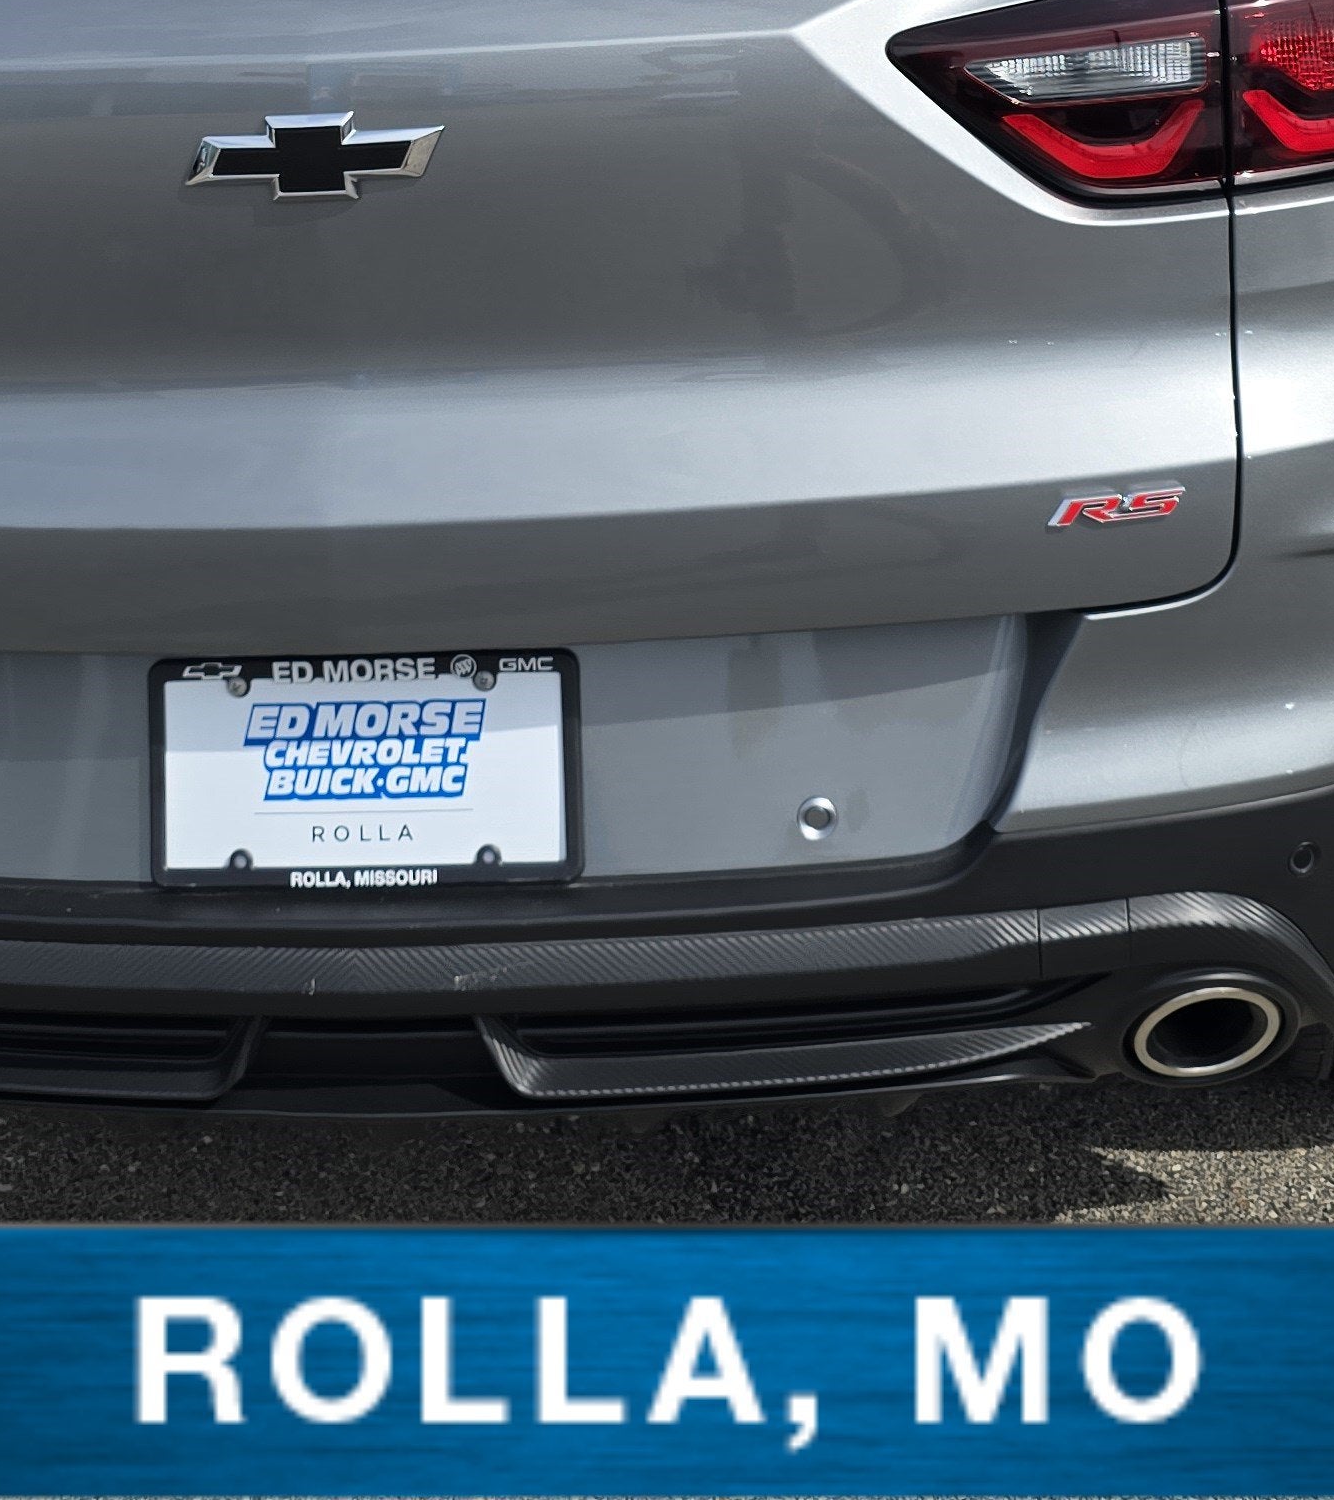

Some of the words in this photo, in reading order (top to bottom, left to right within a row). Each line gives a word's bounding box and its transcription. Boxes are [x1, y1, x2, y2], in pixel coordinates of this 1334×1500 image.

[1046, 485, 1186, 528] RS
[271, 660, 320, 684] ED
[323, 657, 436, 683] MORSE
[498, 655, 554, 673] GMC
[245, 704, 311, 741] ED
[312, 700, 485, 740] MORSE
[264, 737, 468, 768] CHEVROLET
[312, 824, 415, 843] ROLLA
[290, 870, 352, 889] ROLLA,
[354, 869, 439, 887] MISSOURI
